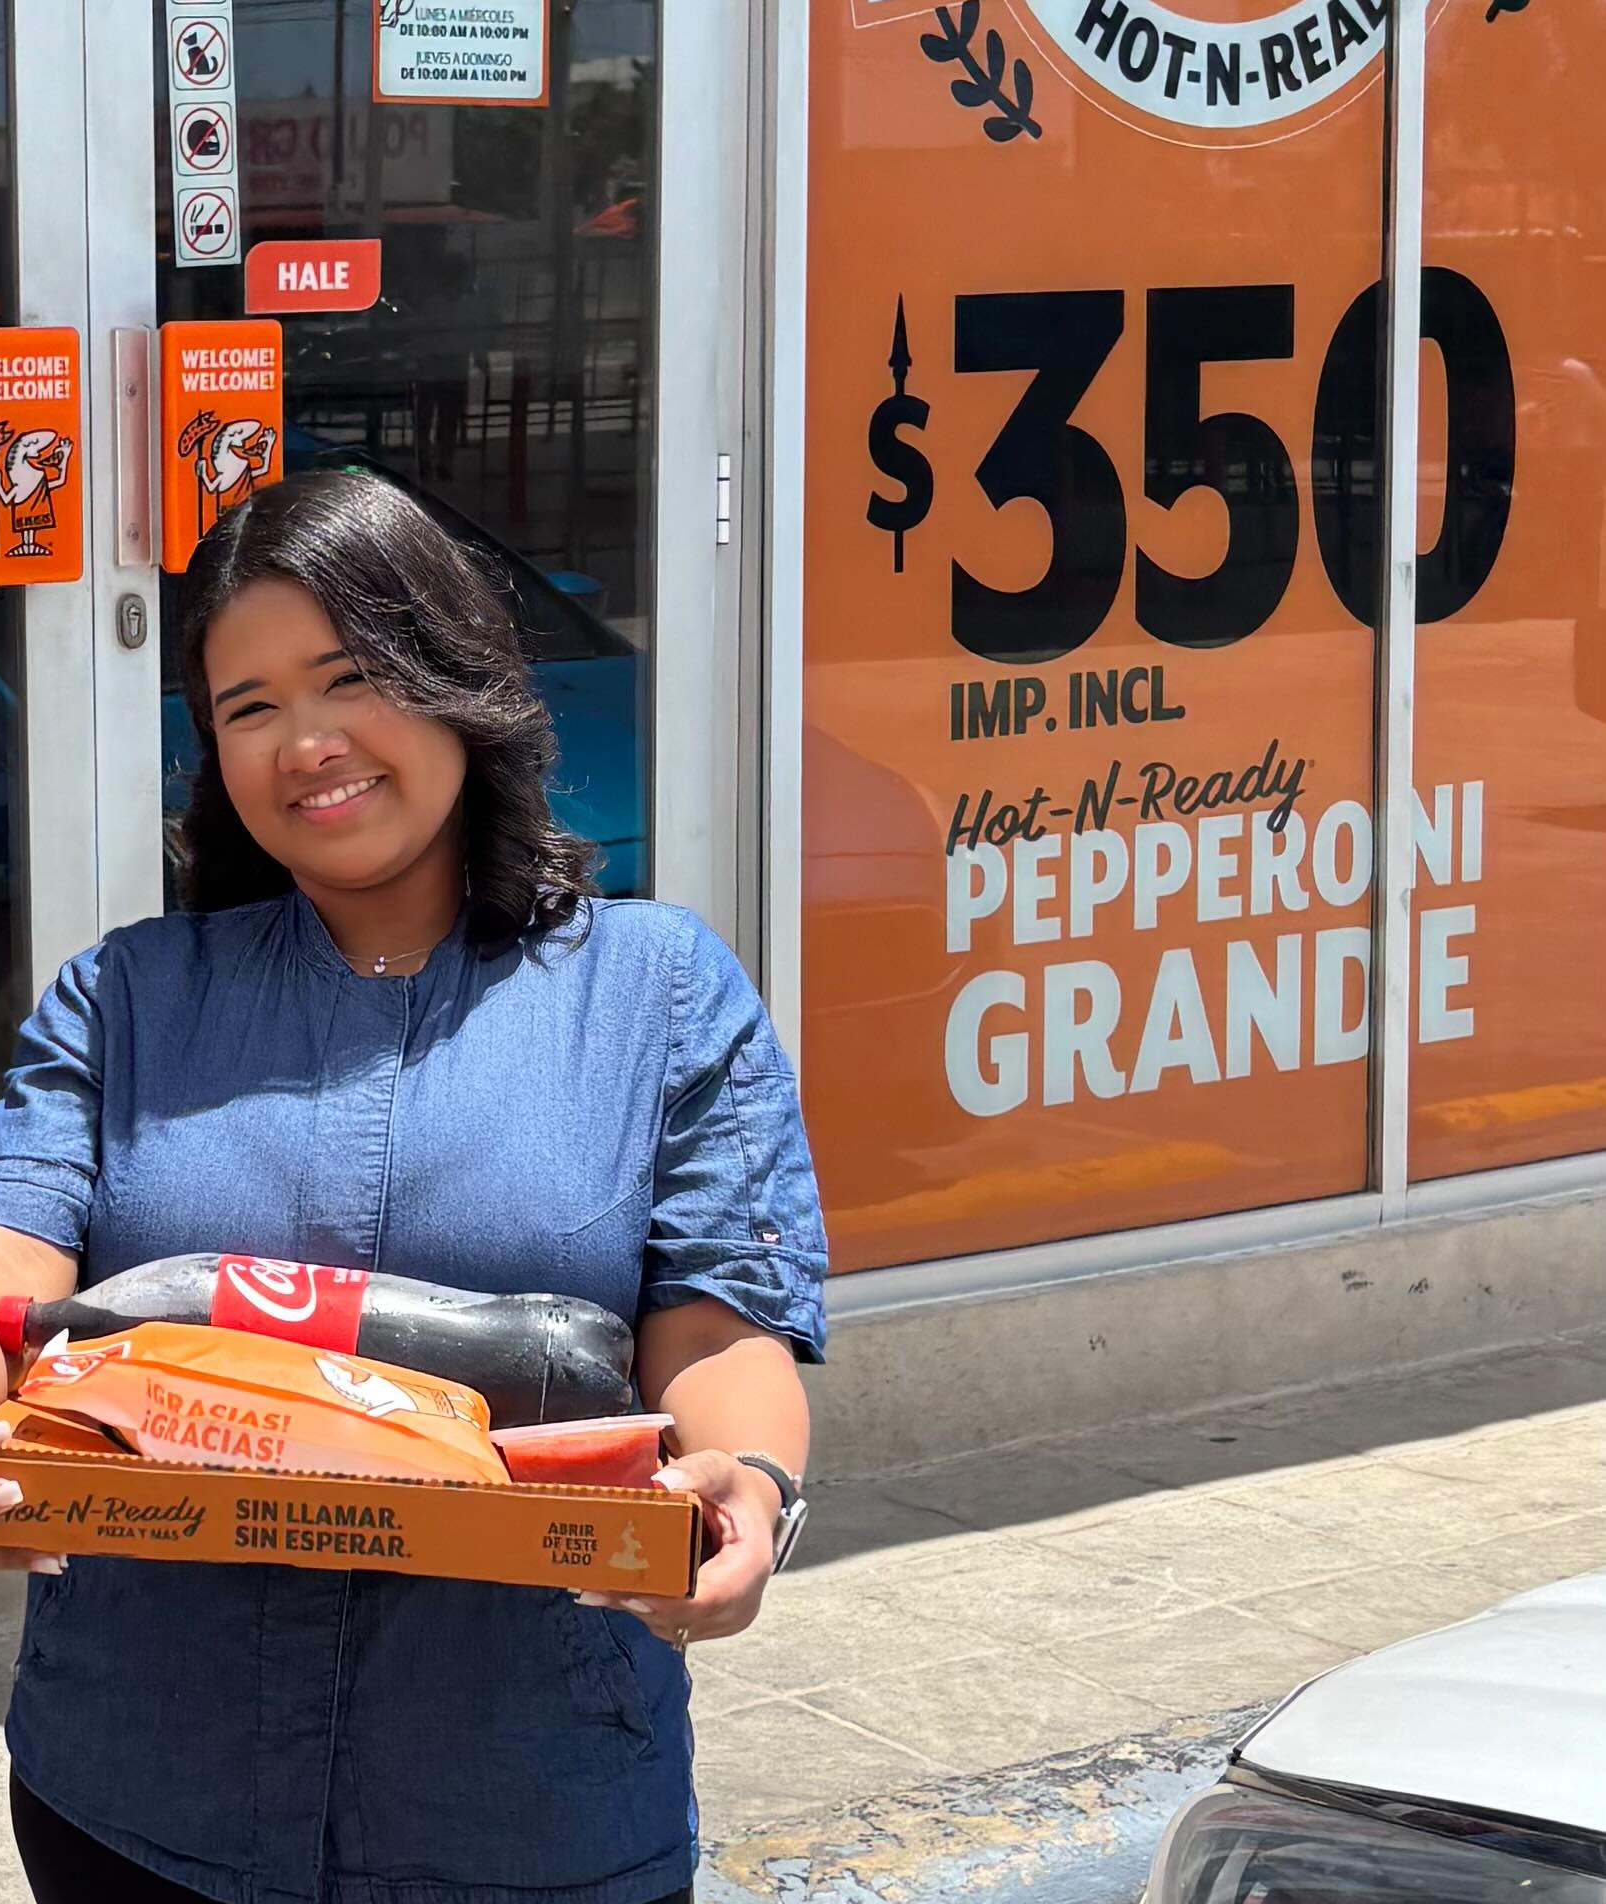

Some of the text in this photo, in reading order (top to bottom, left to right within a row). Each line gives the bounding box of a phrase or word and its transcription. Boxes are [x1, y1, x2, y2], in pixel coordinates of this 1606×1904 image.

[415, 7, 446, 21] LUNES
[449, 8, 456, 21] A
[400, 24, 529, 40] DE 10:00 AM A 10:00 PM
[401, 67, 415, 79] DE
[418, 67, 448, 80] 10:00
[450, 68, 468, 80] AM
[471, 69, 479, 81] A
[510, 70, 527, 82] PM
[416, 51, 512, 67] JUEVES A DOMINGO
[278, 260, 350, 292] HALE
[181, 348, 275, 369] WELCOME!
[181, 370, 275, 392] WELCOME!
[866, 266, 1516, 665] $350
[950, 665, 1186, 742] IMP. INCL.
[946, 737, 1308, 856] Hot-N-Ready
[945, 780, 1484, 953] PEPPERONI
[944, 903, 1477, 1118] GRANDE
[146, 1378, 292, 1432] ¡GRACIAS!
[140, 1409, 285, 1464] ¡GRACIAS!
[235, 1498, 403, 1530] SIN LLAMAR.
[548, 1522, 594, 1537] ABRIR
[235, 1526, 412, 1558] SIN ESPERAR.
[543, 1536, 597, 1551] DE ESTE
[552, 1550, 591, 1565] LADO
